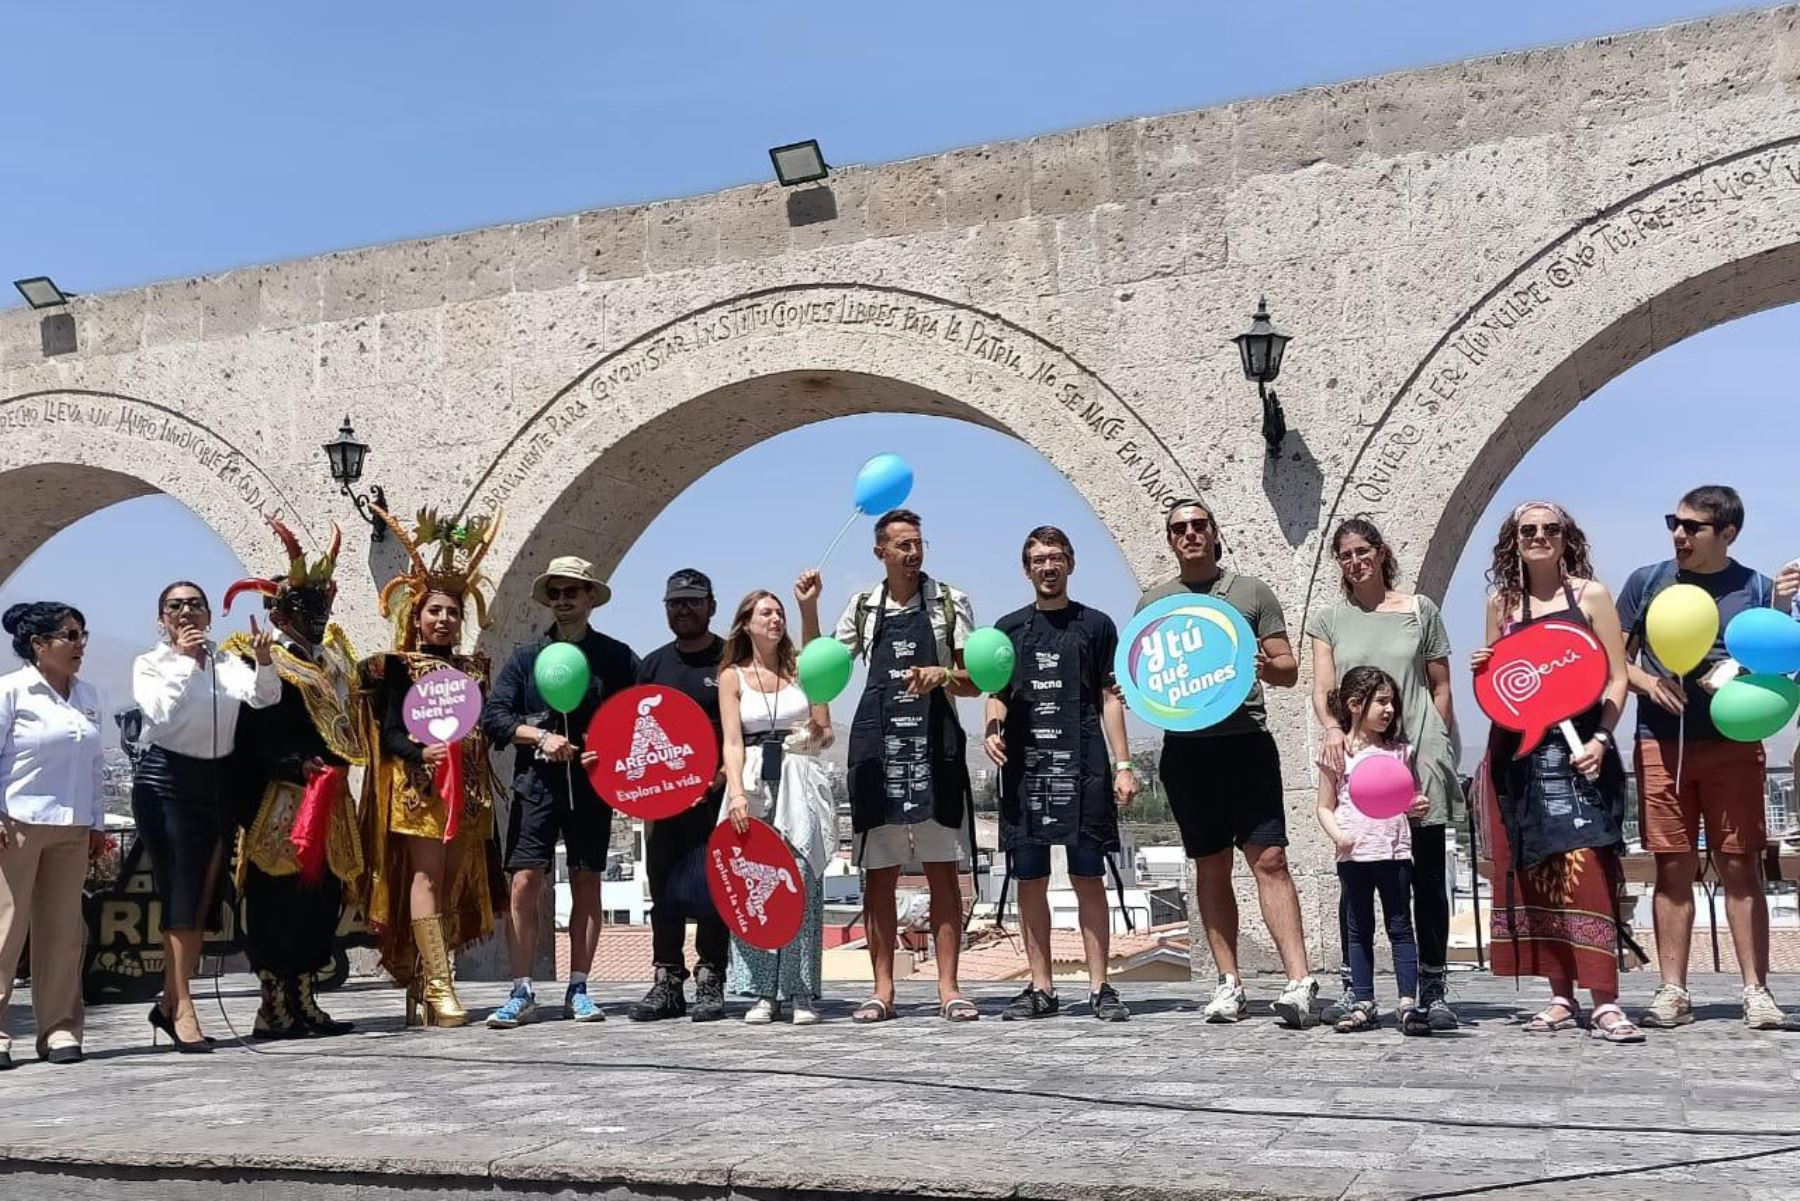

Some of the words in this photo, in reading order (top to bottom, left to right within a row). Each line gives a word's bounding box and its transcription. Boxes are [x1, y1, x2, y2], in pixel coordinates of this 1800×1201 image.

[546, 399, 588, 437] PARA
[591, 335, 691, 400] CONQUISTAR
[694, 300, 836, 349] INSTITUCIONES
[839, 294, 903, 327] LIBRES
[901, 306, 939, 336] PARA
[1079, 402, 1125, 440] NACE
[1116, 441, 1143, 467] EN
[1415, 367, 1469, 413] SER
[416, 678, 468, 698] Viajar
[1030, 680, 1063, 690] Tacna
[1148, 655, 1190, 693] qué
[1169, 664, 1237, 707] planes
[411, 706, 443, 720] bien
[615, 743, 694, 773] AREQUIPA
[616, 785, 662, 802] Explora
[663, 780, 675, 792] la
[676, 774, 701, 788] vida
[712, 849, 733, 893] Explora
[735, 907, 748, 933] vida
[731, 846, 768, 926] AREQUIPA
